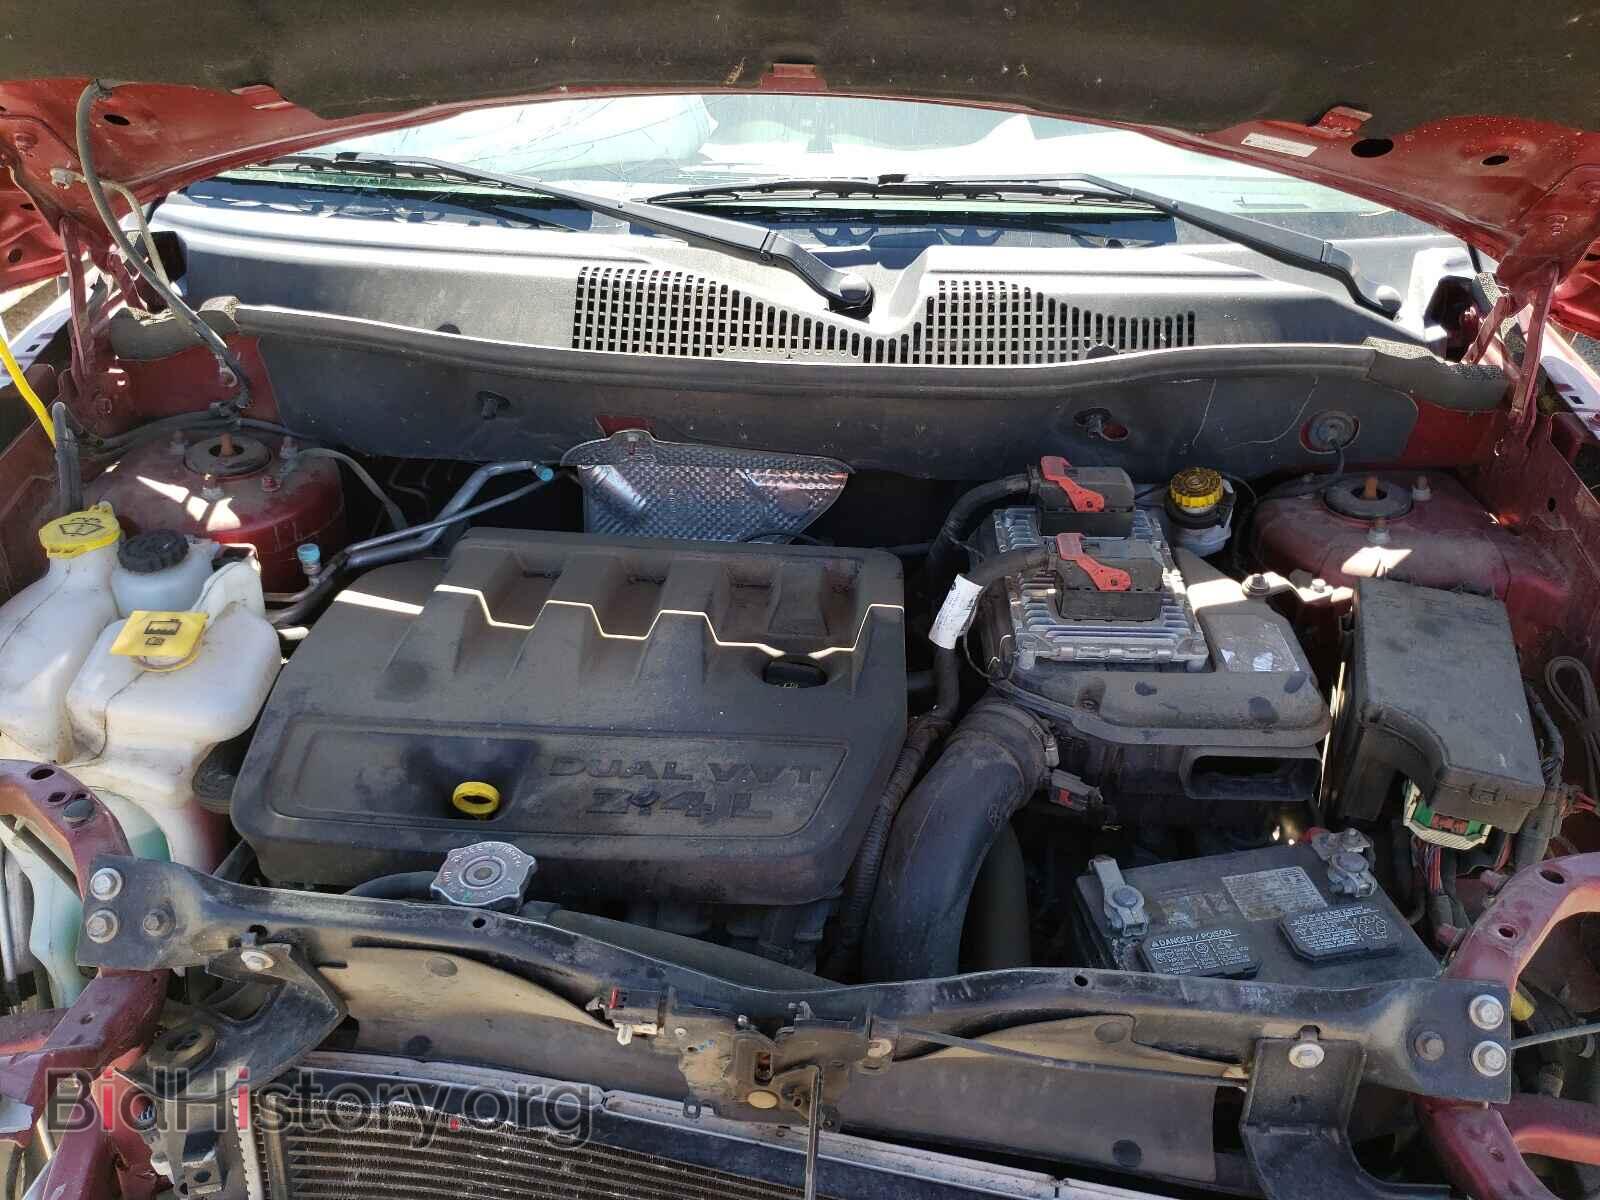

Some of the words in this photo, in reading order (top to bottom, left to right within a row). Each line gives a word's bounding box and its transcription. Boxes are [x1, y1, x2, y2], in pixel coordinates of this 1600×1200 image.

[548, 757, 693, 781] DUAL
[707, 761, 822, 785] VVT
[1159, 935, 1194, 947] DANGER
[1200, 928, 1232, 940] POISON
